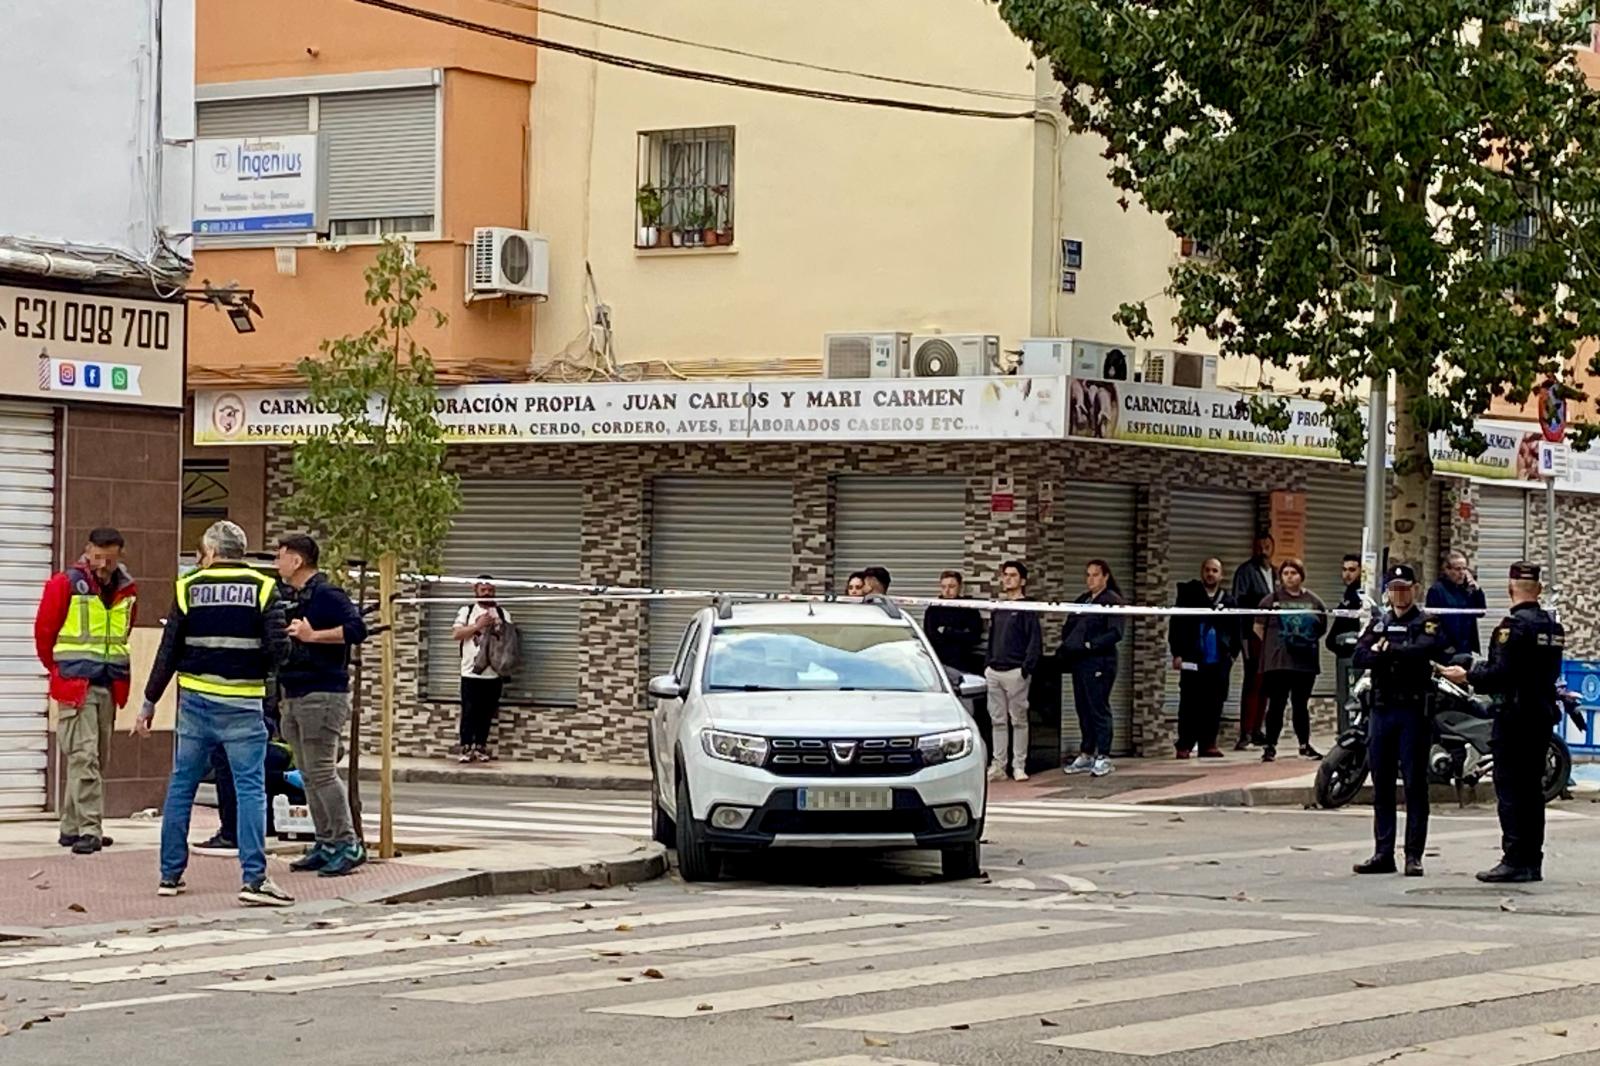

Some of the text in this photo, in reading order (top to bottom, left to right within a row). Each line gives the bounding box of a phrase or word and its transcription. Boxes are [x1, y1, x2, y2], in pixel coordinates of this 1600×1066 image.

[237, 143, 302, 180] Ingenius
[15, 297, 170, 350] 631 098 700
[524, 396, 596, 413] PROPIA
[622, 393, 677, 411] JUAN
[688, 391, 769, 409] CARLOS
[780, 391, 796, 408] Y
[806, 390, 862, 408] MARI
[873, 388, 965, 407] CARMEN
[1124, 394, 1202, 417] CARNICERÍA
[447, 423, 523, 437] TERNERA,
[529, 421, 586, 437] CERDO,
[591, 421, 670, 436] CORDERO,
[676, 420, 722, 435] AVES,
[729, 418, 842, 432] ELABORADOS
[847, 417, 925, 431] CASEROS
[1127, 420, 1203, 438] ESPECIALIDAD
[1208, 427, 1222, 440] EN
[1228, 429, 1286, 445] BARBACOAS
[1292, 434, 1300, 447] Y
[190, 584, 255, 605] POLICIA
